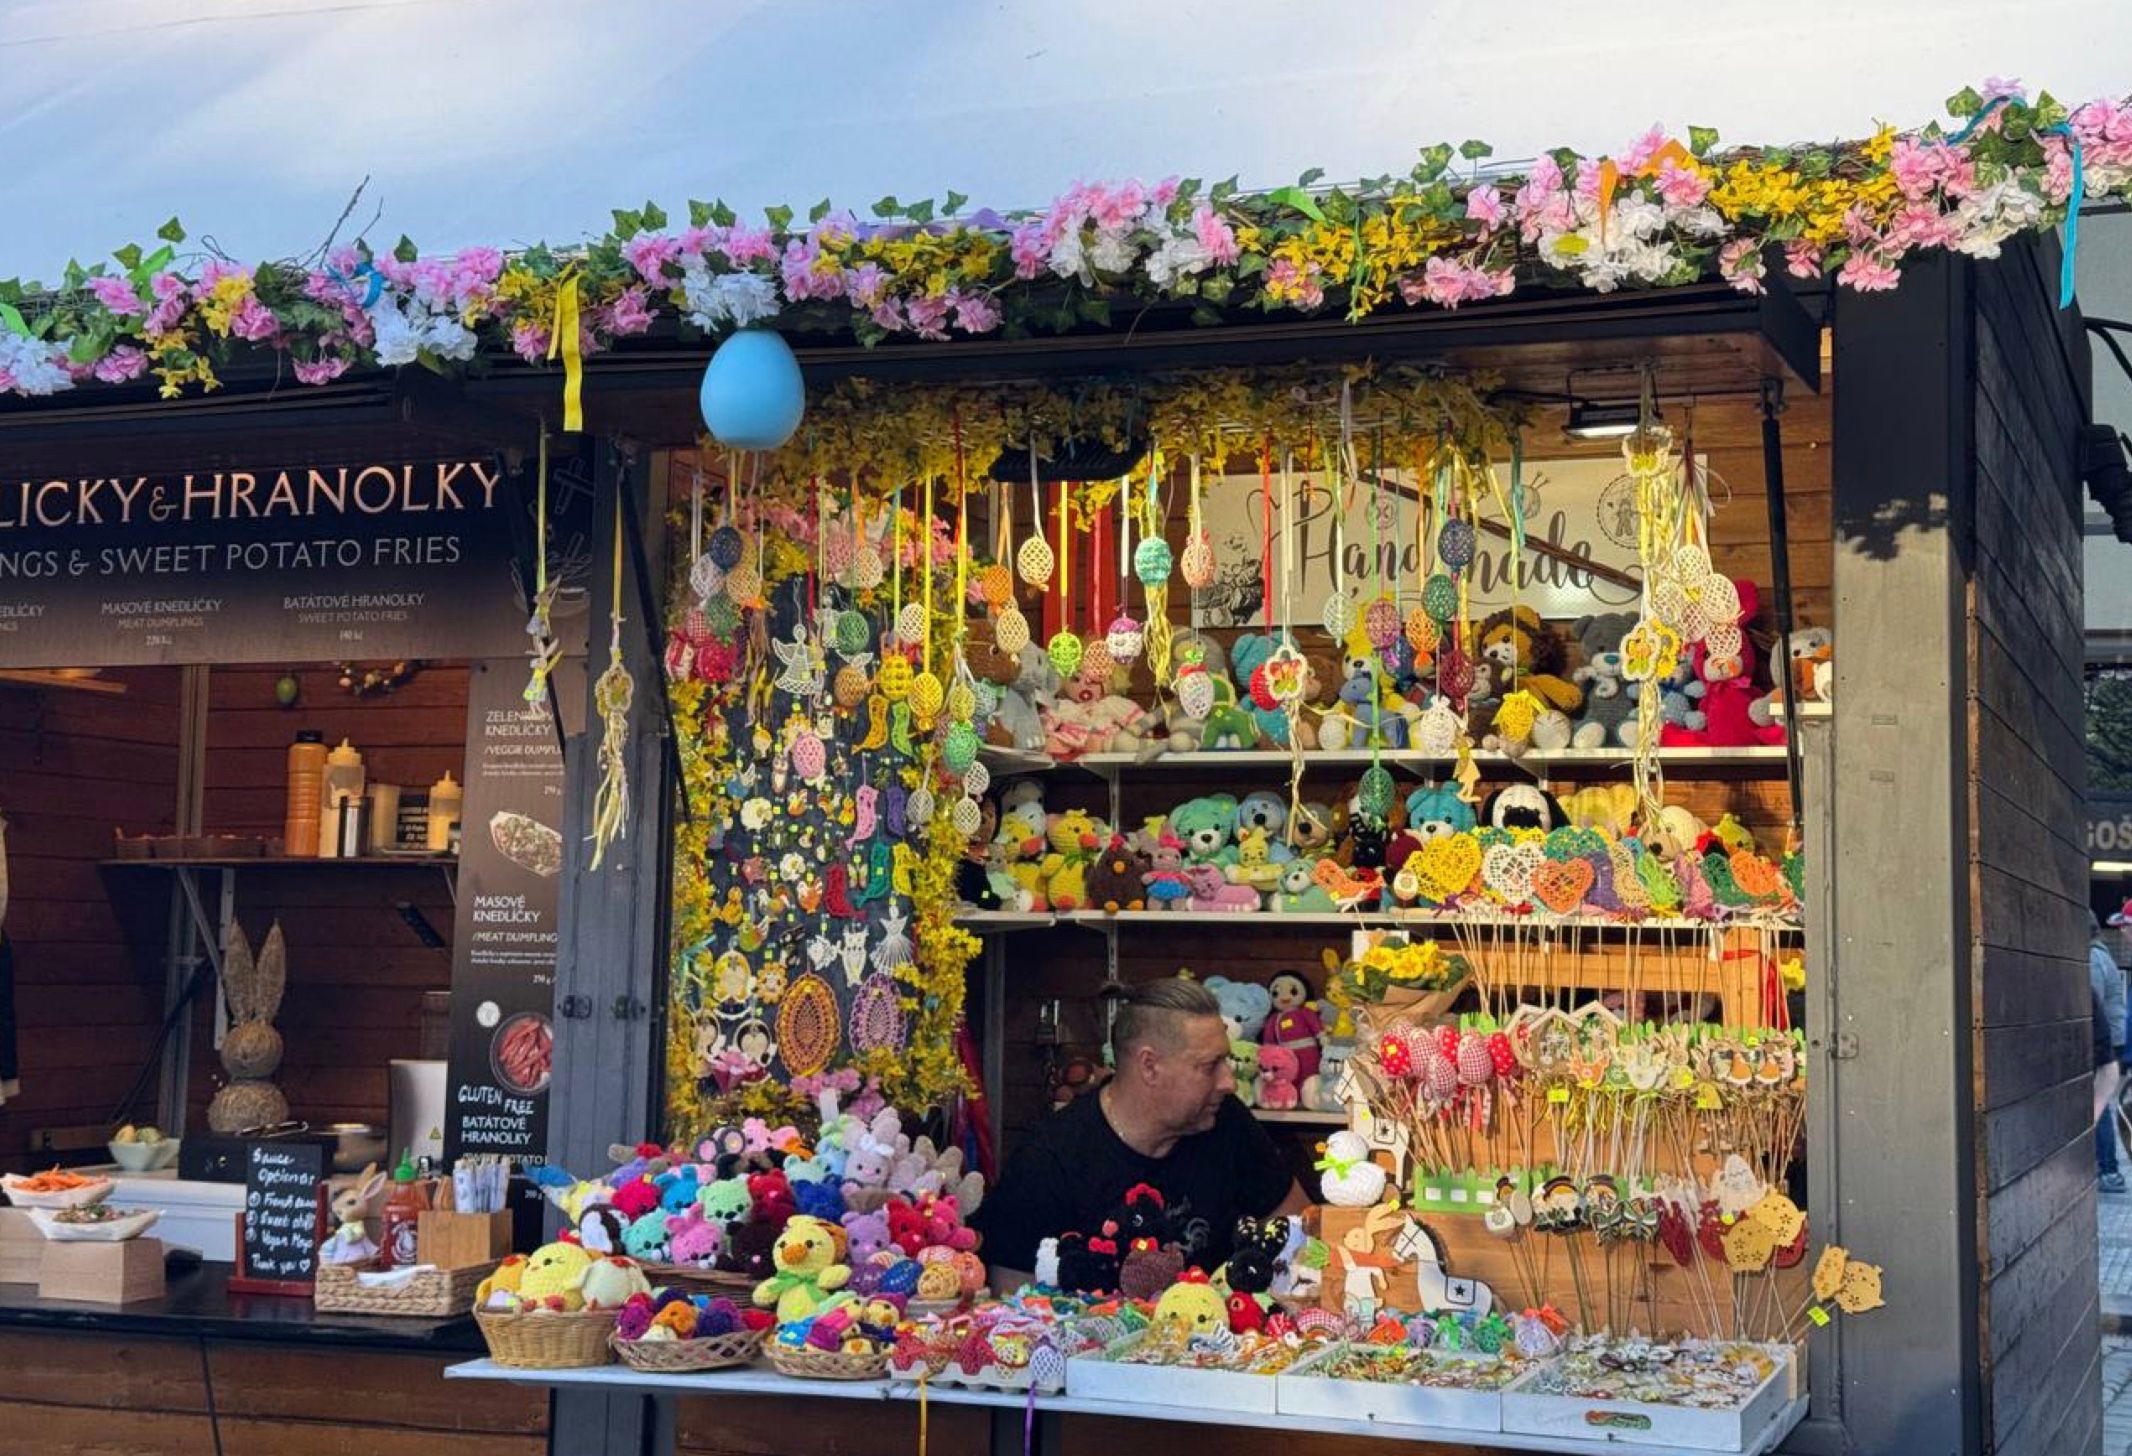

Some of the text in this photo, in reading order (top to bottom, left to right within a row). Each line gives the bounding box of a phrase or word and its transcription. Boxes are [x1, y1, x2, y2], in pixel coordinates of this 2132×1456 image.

[182, 463, 501, 520] HRANOLKY
[68, 549, 90, 575] &
[101, 545, 216, 574] SWEET
[227, 539, 361, 570] POTATO
[373, 537, 460, 565] FRIES
[352, 593, 424, 608] HRANOLKY
[474, 894, 526, 909] MASOVÉ
[473, 909, 541, 923] KNEDLÍČKY
[458, 1085, 535, 1115] GLUTEN FREE
[462, 1114, 527, 1130] BATÁTOVÉ
[461, 1131, 533, 1145] HRANOLKY
